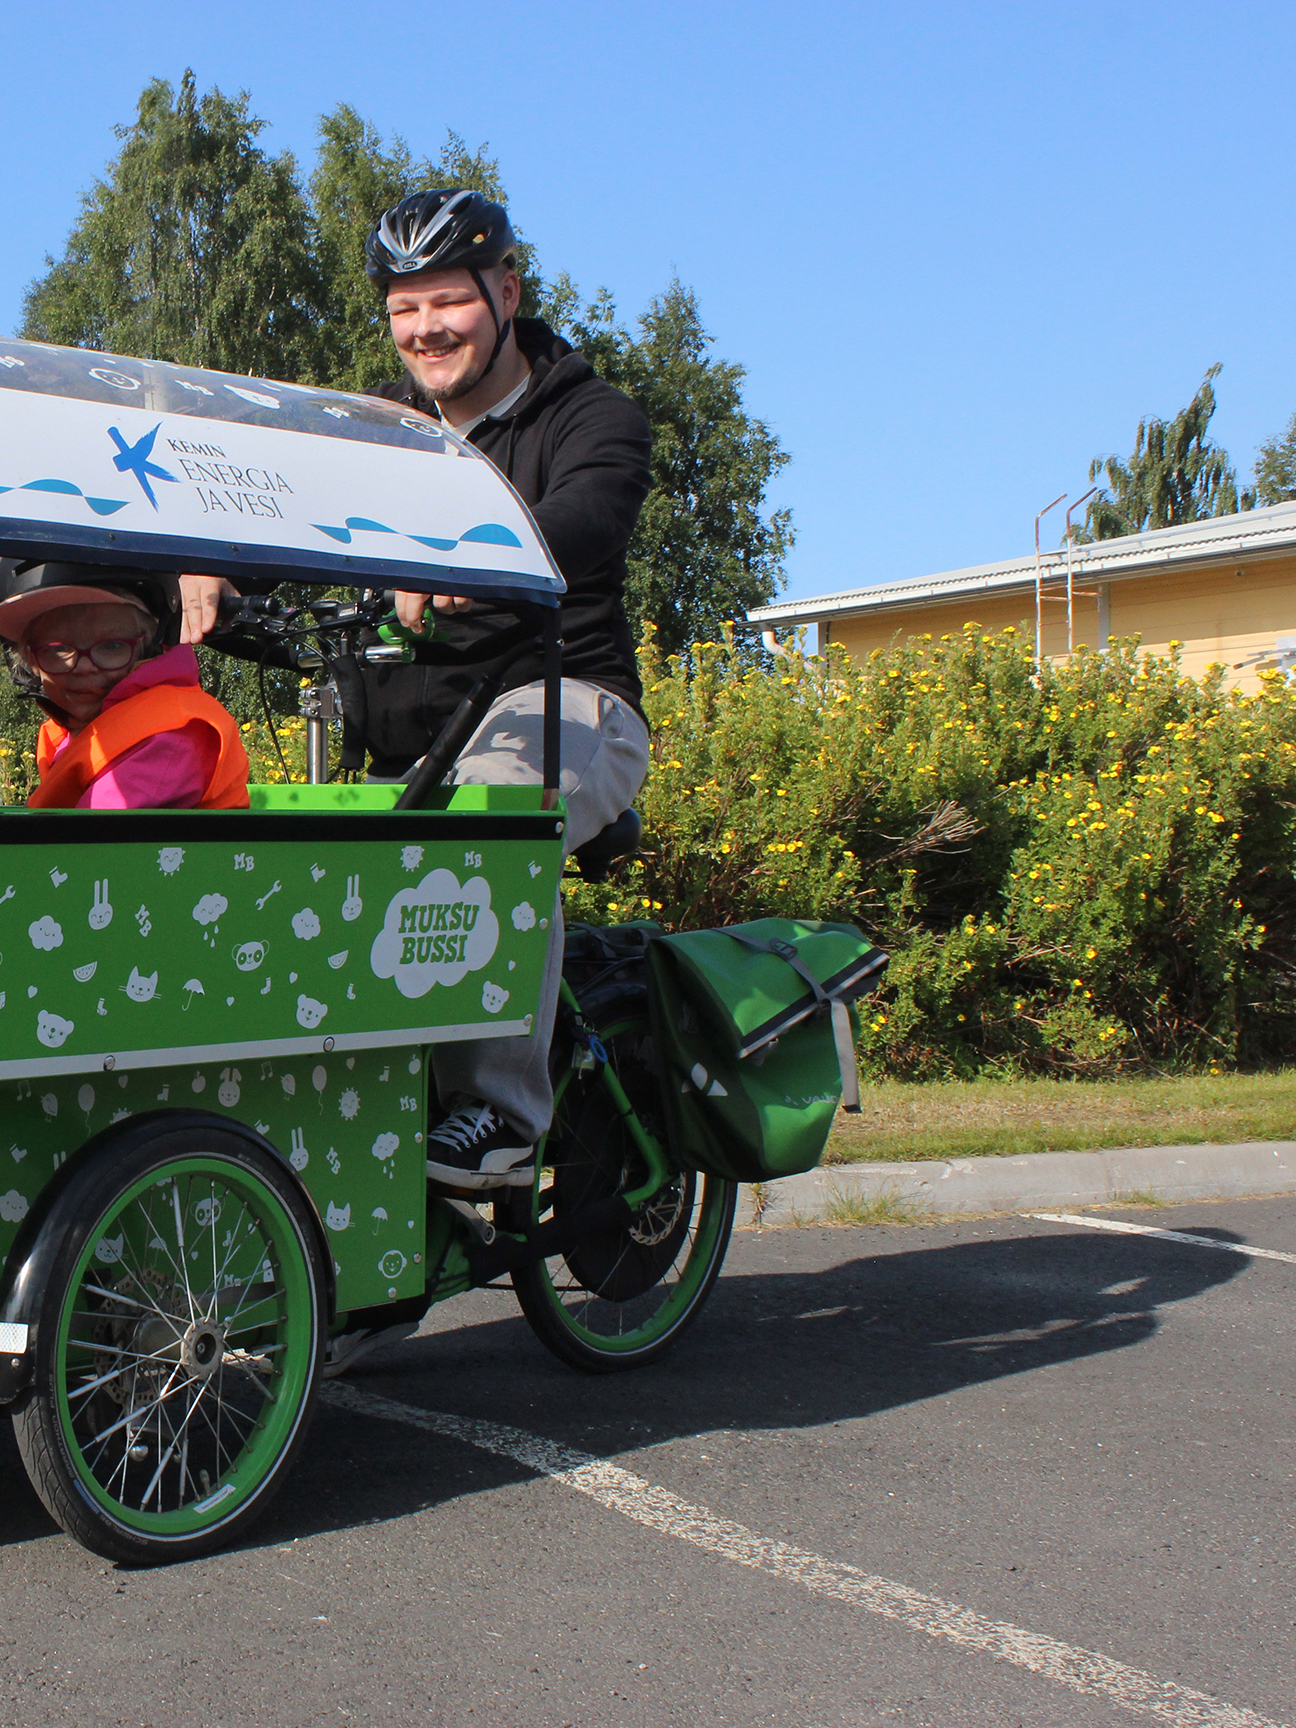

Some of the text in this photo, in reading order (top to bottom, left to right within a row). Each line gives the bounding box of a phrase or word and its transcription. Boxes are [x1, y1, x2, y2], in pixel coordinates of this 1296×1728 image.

[166, 438, 227, 459] KEMIN
[178, 458, 295, 494] ENERGIA
[195, 487, 285, 519] JA VESI
[234, 852, 255, 872] MB
[465, 850, 482, 869] MB
[135, 904, 153, 938] MB
[398, 900, 479, 933] MUKSU
[399, 934, 468, 965] BUSSI
[399, 1095, 417, 1112] MB
[801, 1094, 839, 1104] VAUD
[326, 1146, 341, 1175] MB
